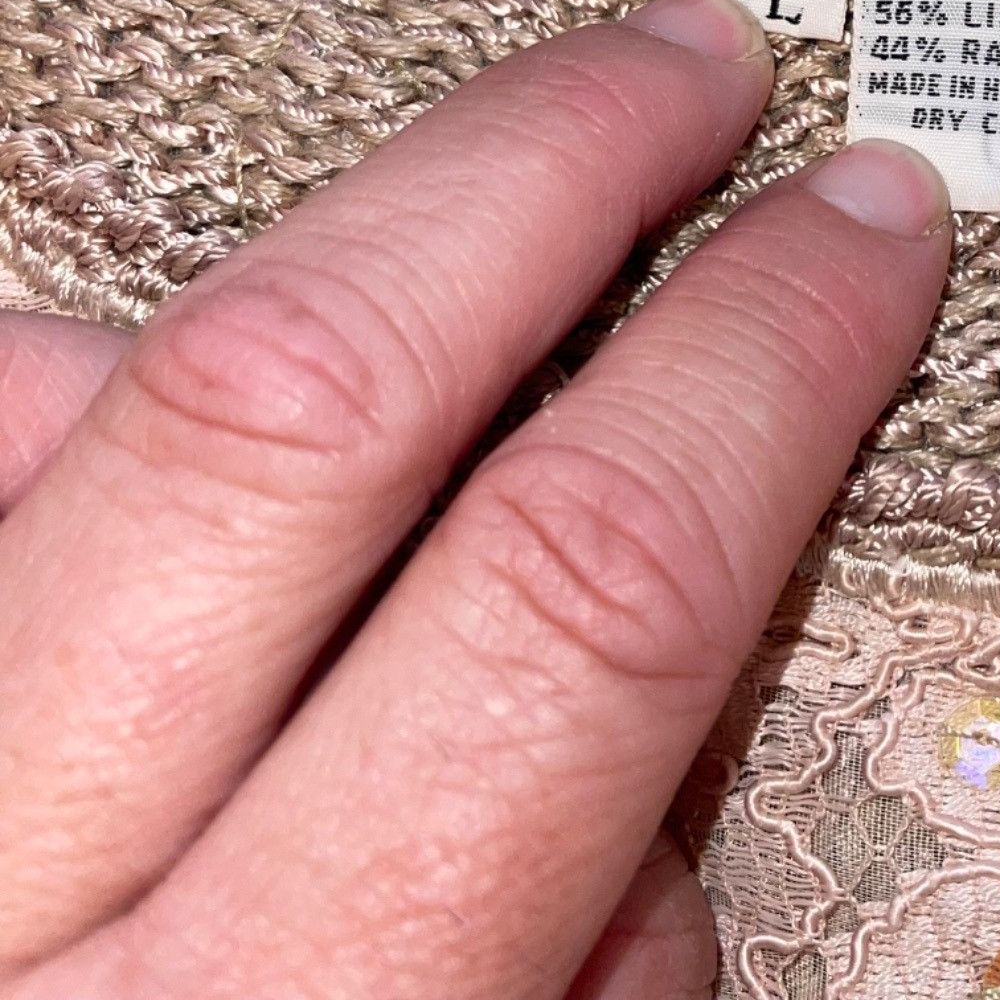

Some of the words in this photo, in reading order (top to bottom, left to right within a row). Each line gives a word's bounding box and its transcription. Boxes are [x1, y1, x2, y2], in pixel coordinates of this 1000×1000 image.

[874, 0, 948, 26] 56%
[870, 35, 947, 64] 44%
[867, 72, 943, 97] MADE
[950, 75, 976, 100] IN
[911, 107, 968, 132] DRY
